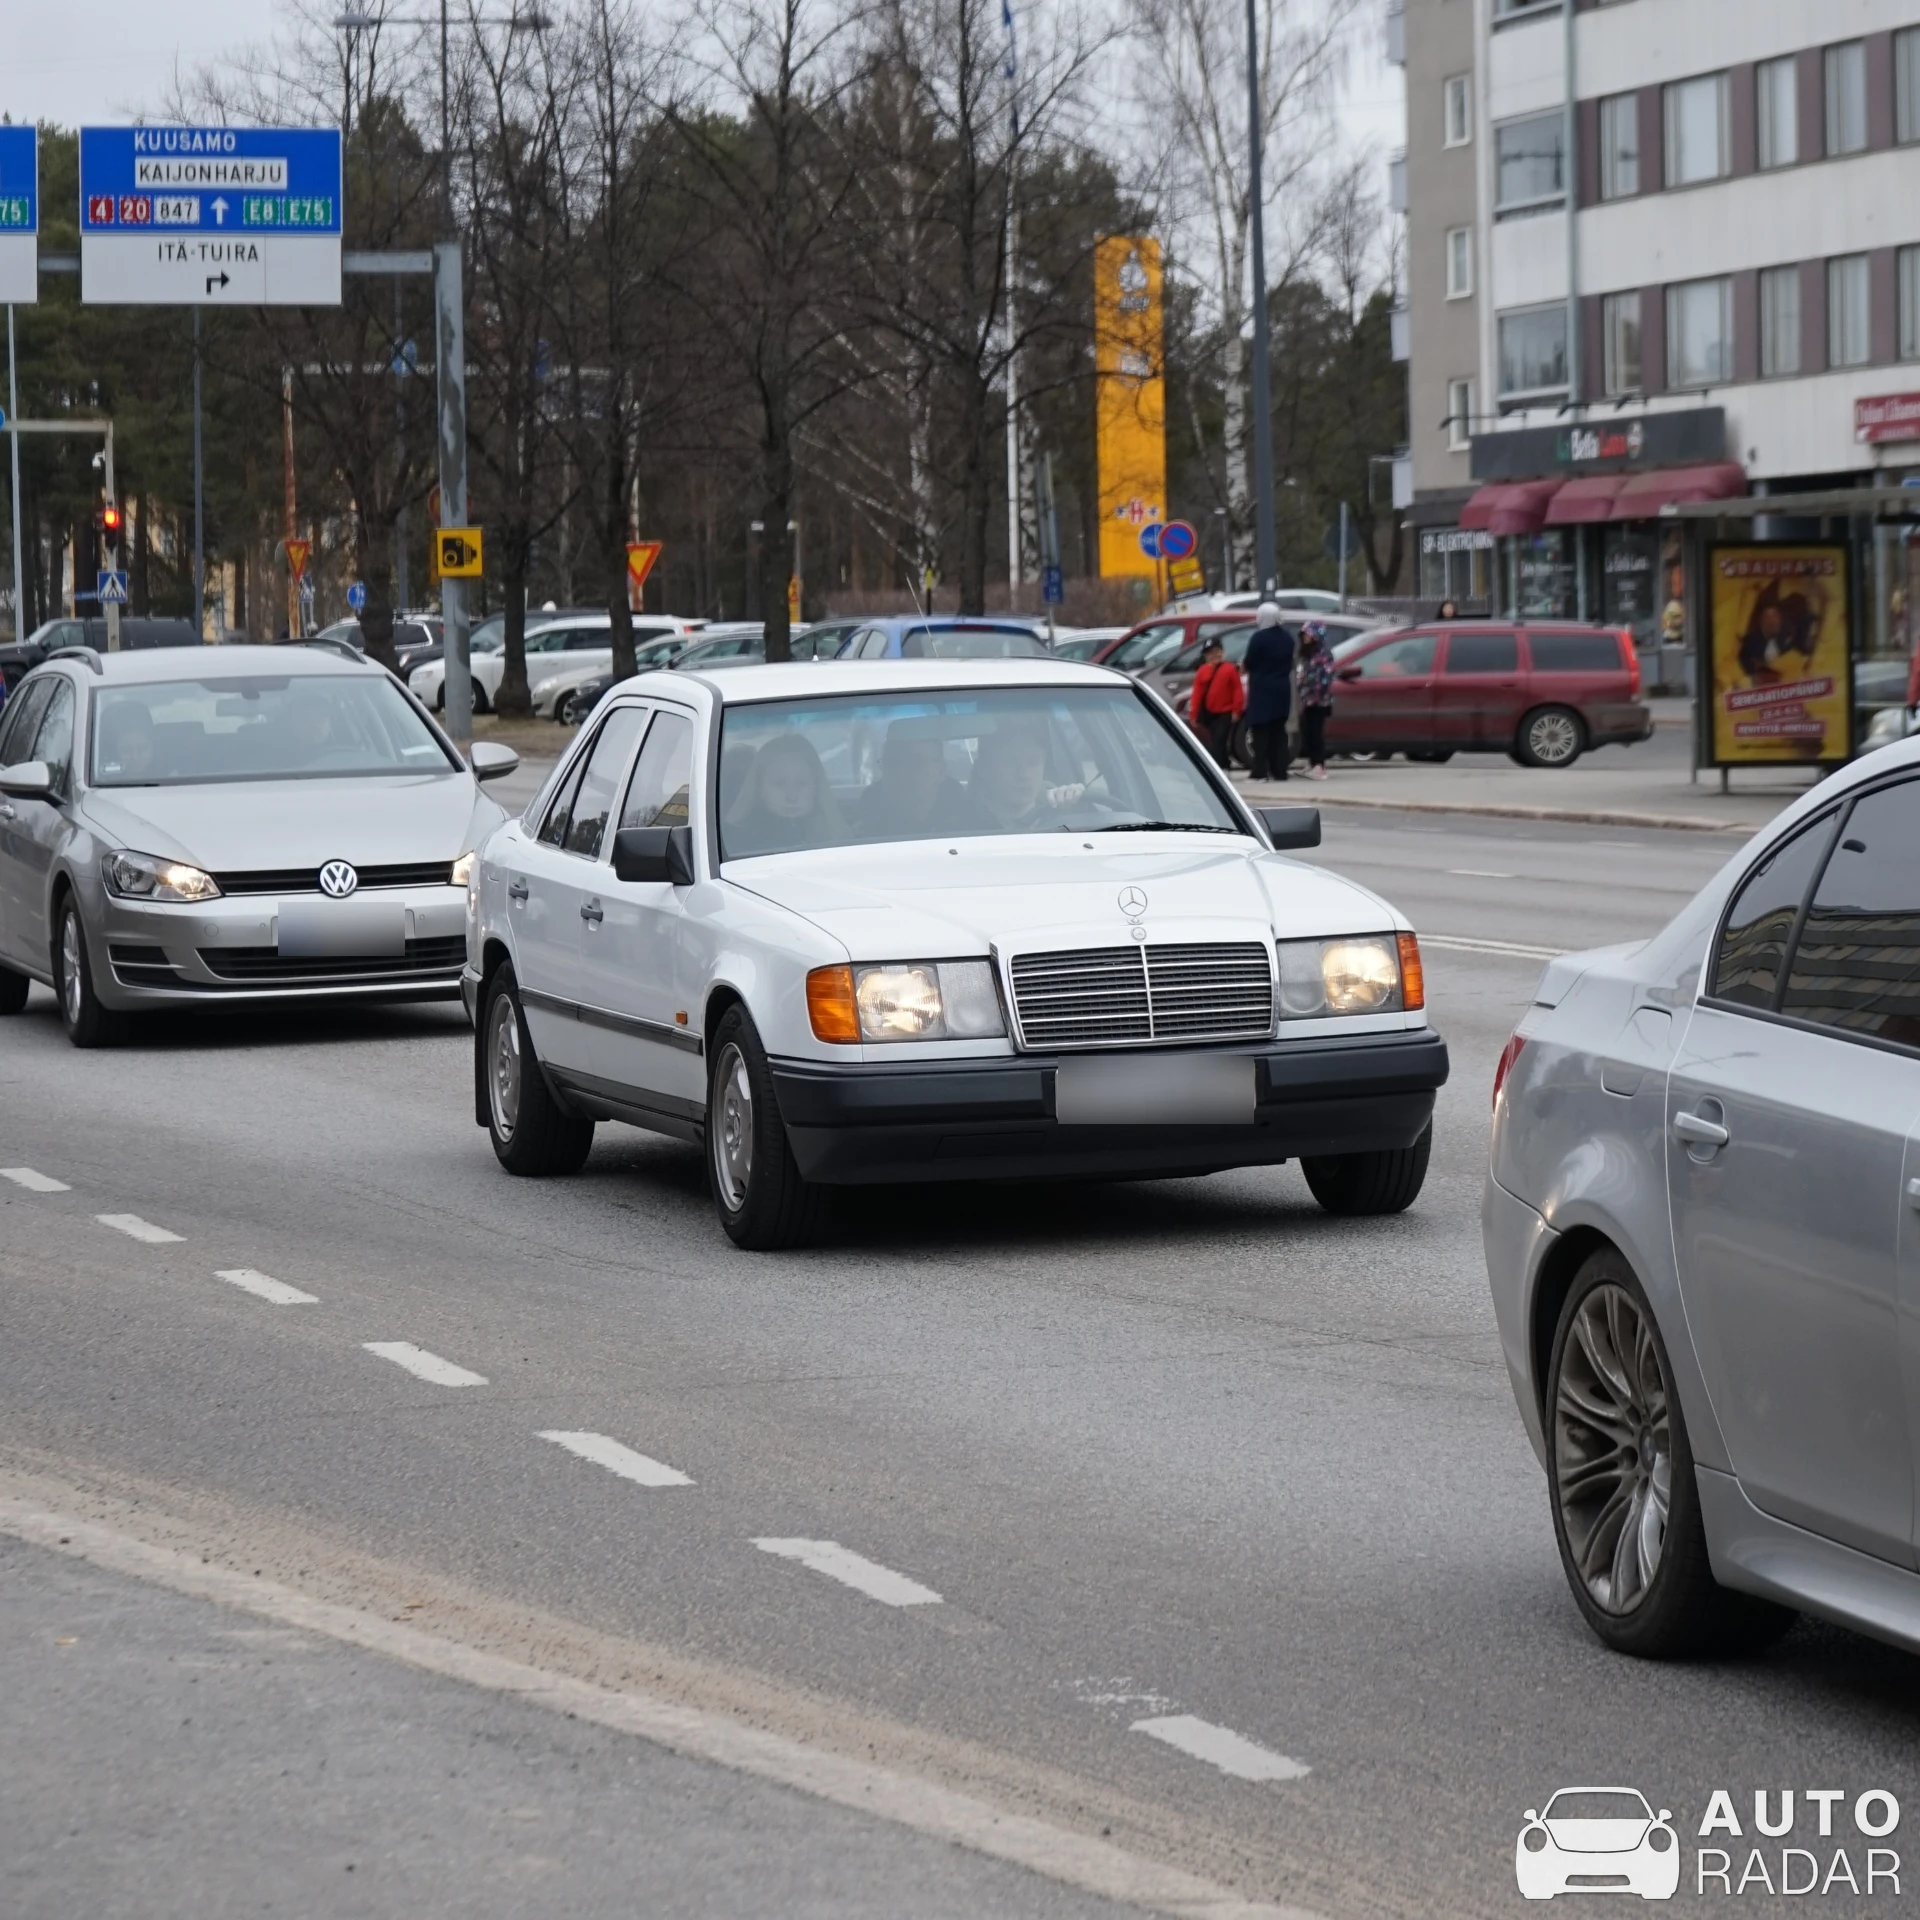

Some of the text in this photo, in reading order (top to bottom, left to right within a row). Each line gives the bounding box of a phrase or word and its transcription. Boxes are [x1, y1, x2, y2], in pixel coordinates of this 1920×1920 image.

[134, 131, 236, 152] KUUSAMO
[139, 162, 283, 184] KAIJONHARJU
[95, 200, 325, 221] 4 20 847 E8 E75
[157, 238, 260, 262] ITÄ-TUIRA
